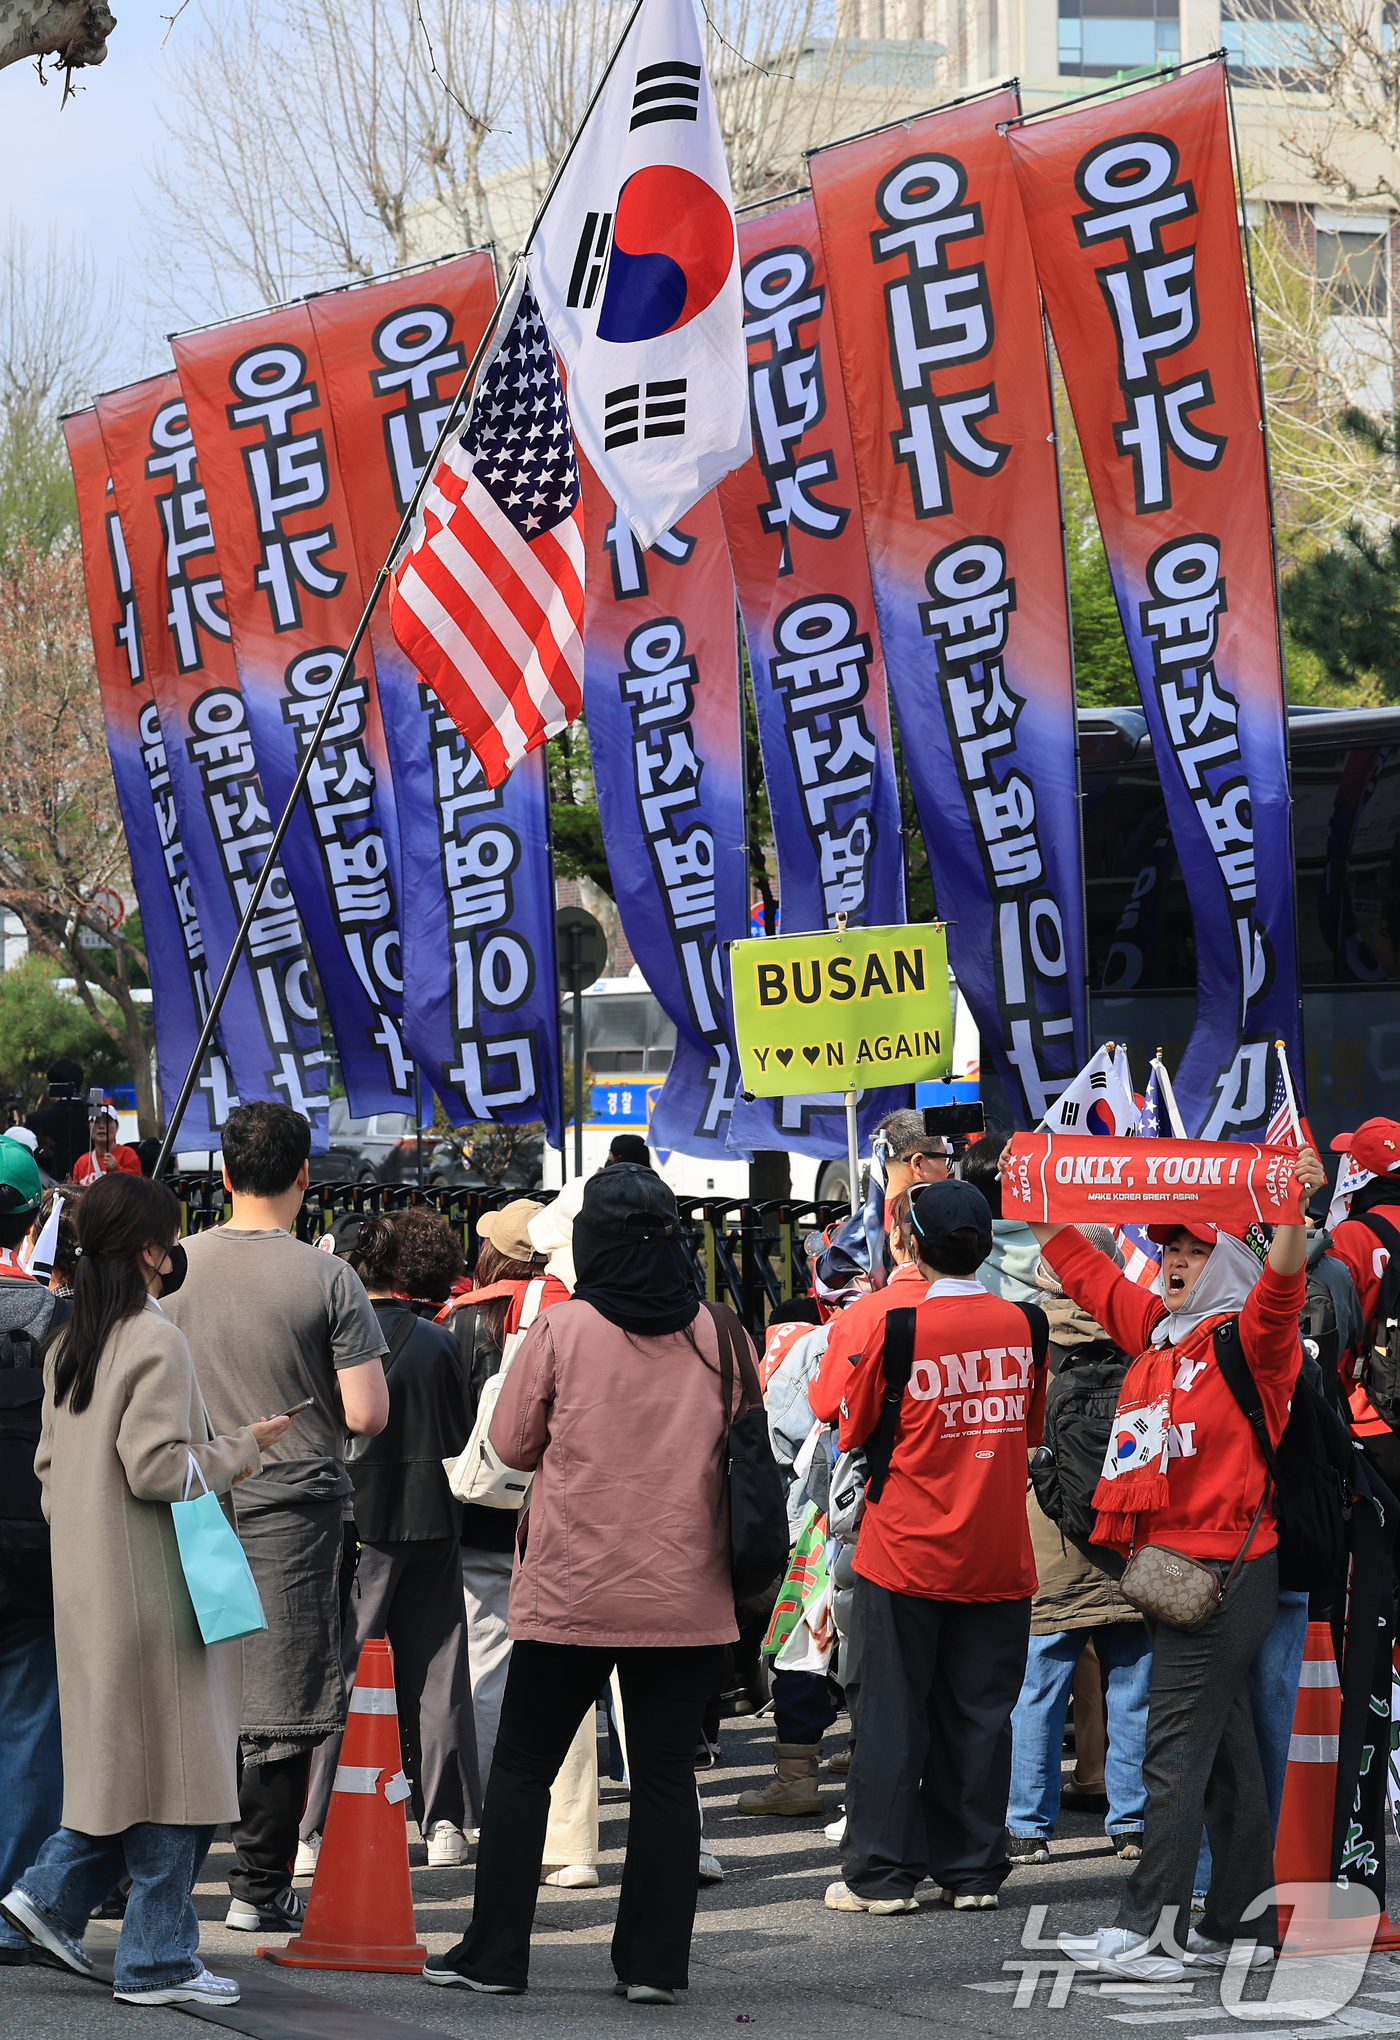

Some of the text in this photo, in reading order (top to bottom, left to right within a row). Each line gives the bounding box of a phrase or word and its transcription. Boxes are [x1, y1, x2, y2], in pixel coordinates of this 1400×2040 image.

[756, 947, 926, 1007] BUSAN
[856, 1030, 942, 1065] AGAIN
[1018, 1152, 1034, 1203] YOON
[1055, 1155, 1242, 1188] ONLY, YOON!
[1087, 1193, 1199, 1201] MAKE KOREA GREAT AGAIN
[937, 1394, 1026, 1428] YOON
[940, 1432, 960, 1440] MAKE
[962, 1429, 981, 1437] YOON
